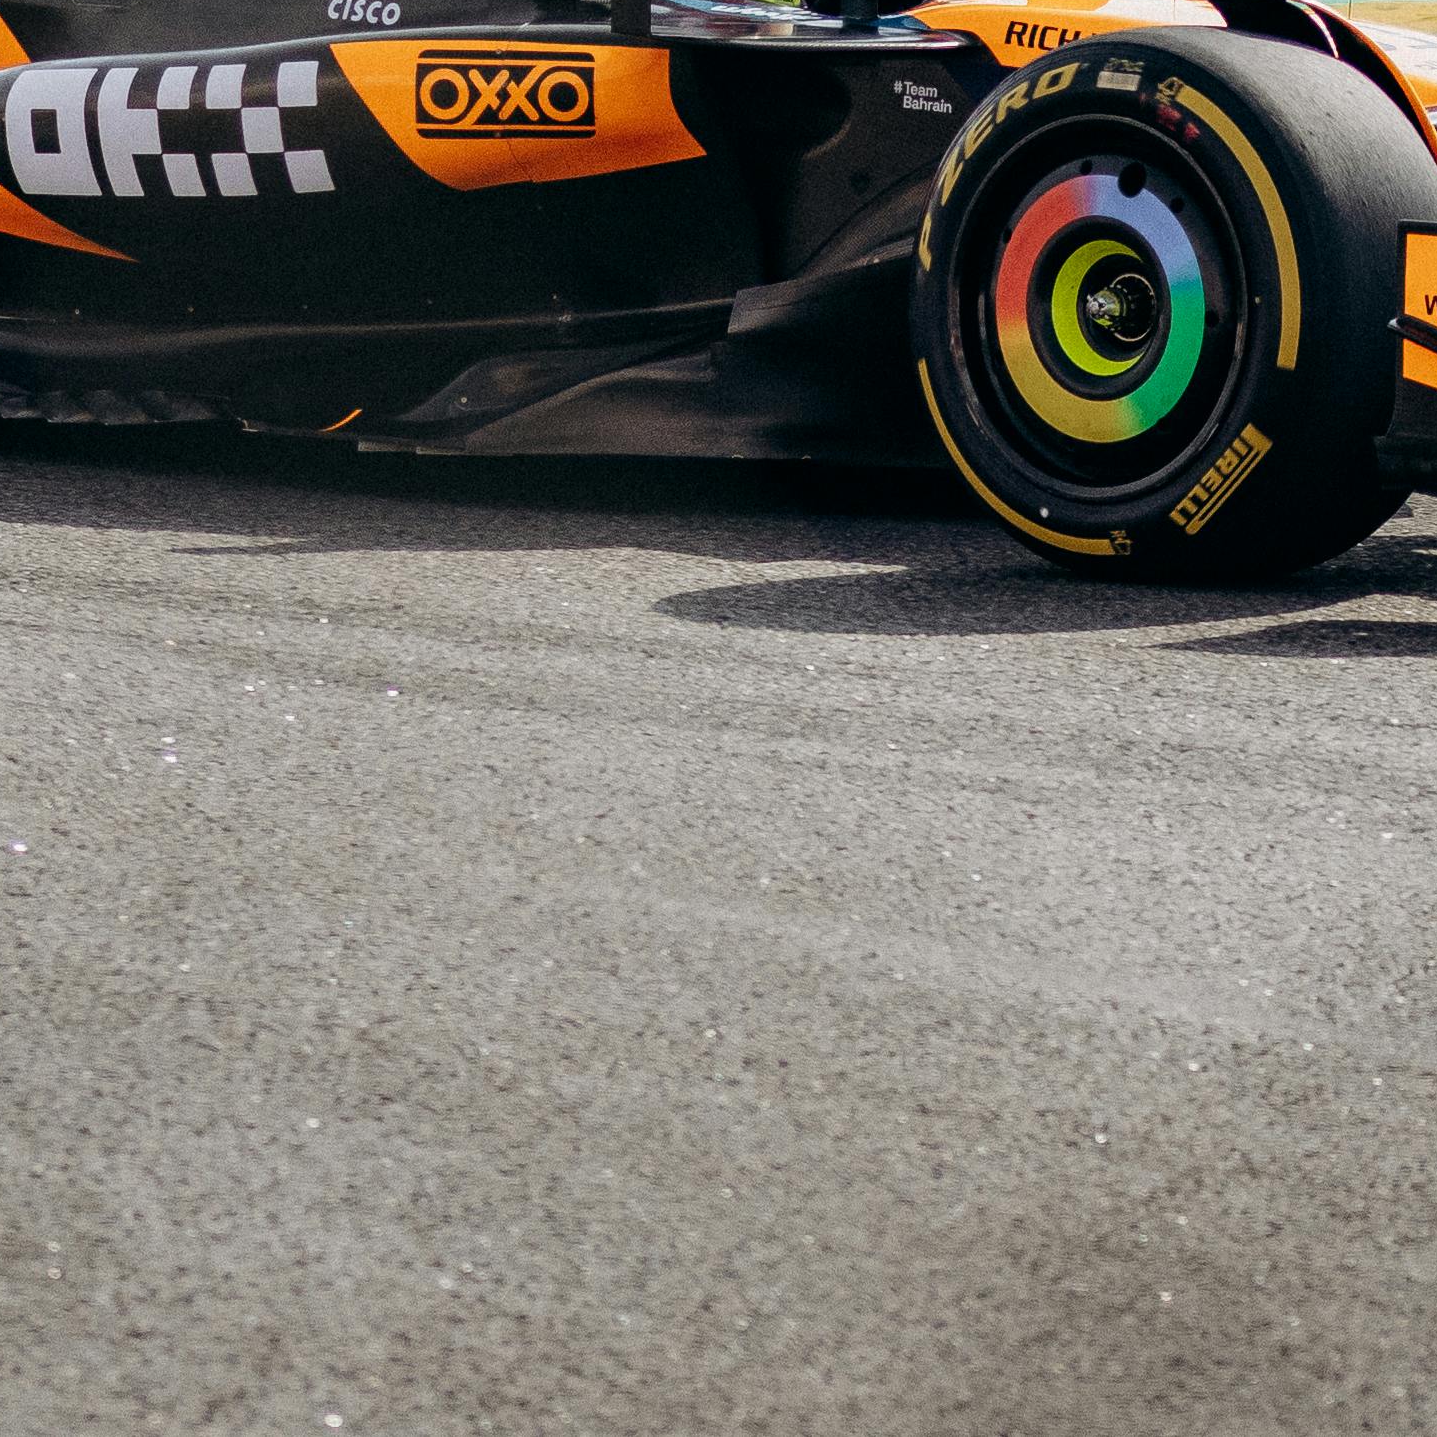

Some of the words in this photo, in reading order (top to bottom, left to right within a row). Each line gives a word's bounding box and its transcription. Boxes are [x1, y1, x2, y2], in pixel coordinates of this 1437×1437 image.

[1004, 21, 1095, 51] RICH
[420, 65, 590, 124] OXXO
[894, 80, 938, 98] #Team
[903, 95, 953, 114] Bahrain
[5, 61, 336, 197] OKX
[1169, 423, 1274, 535] PIRELLI
